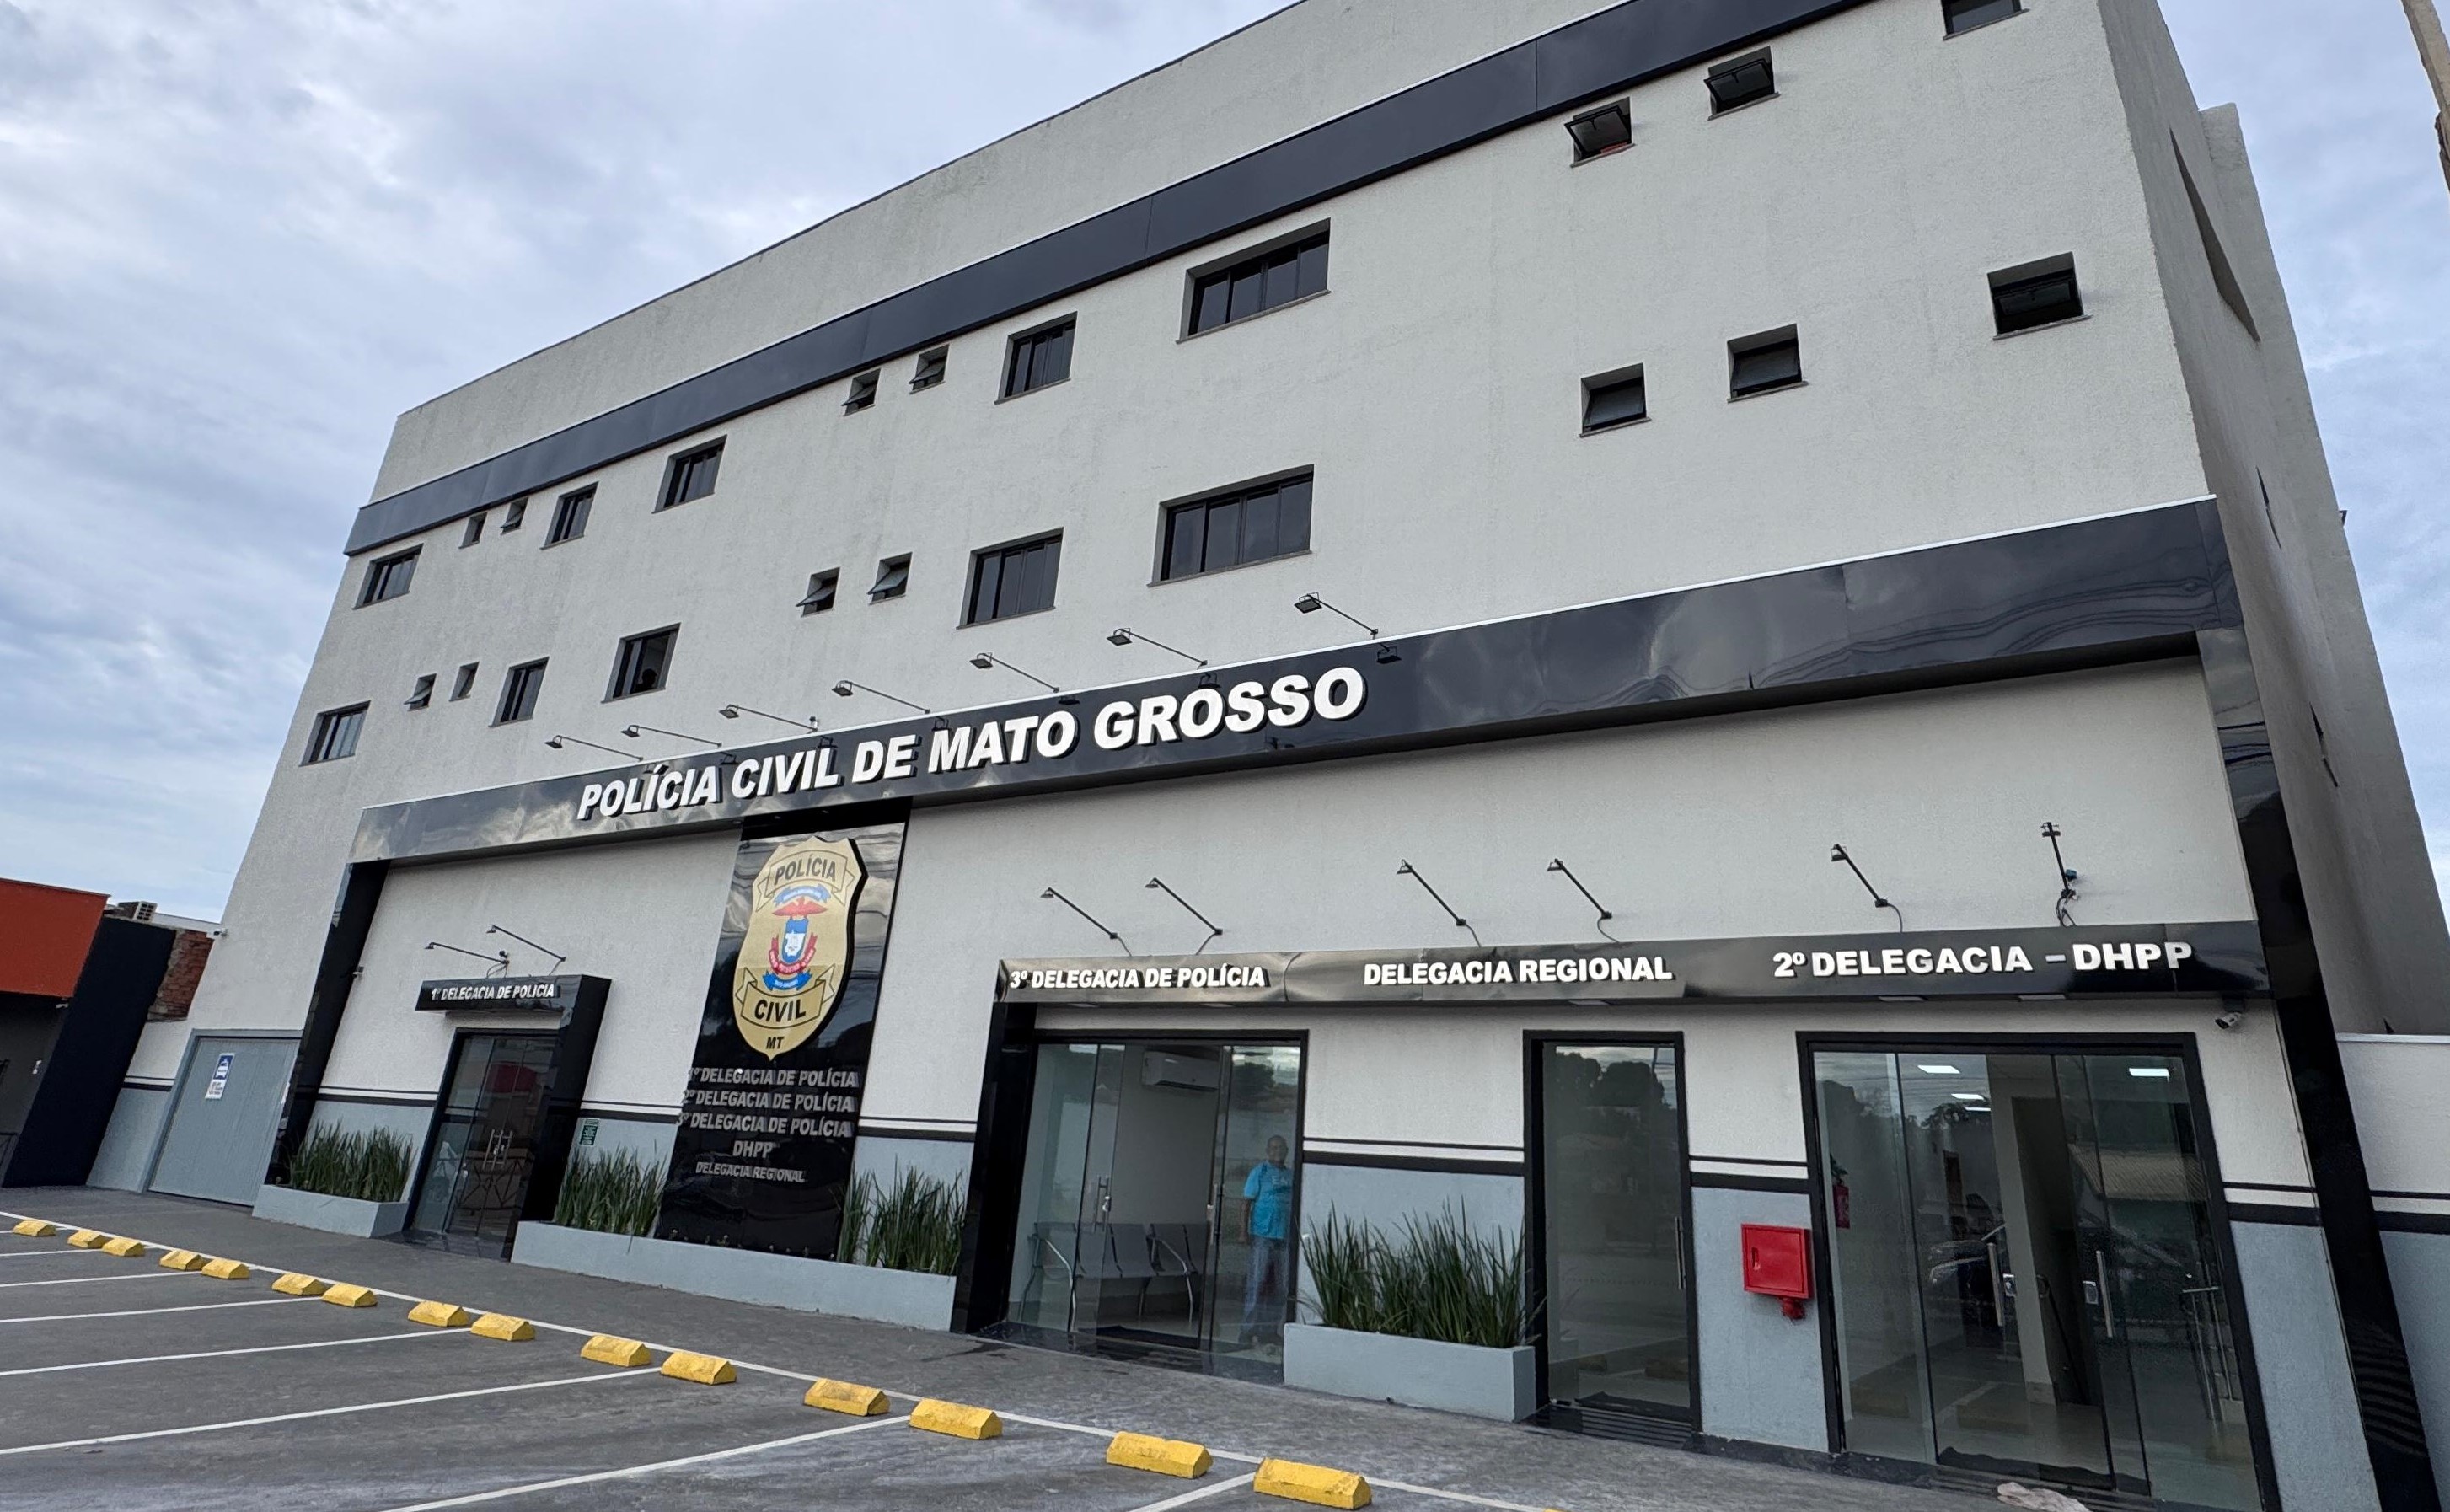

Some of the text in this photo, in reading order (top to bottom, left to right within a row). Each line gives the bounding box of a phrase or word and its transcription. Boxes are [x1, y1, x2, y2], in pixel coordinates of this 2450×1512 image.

[576, 666, 1365, 820] POLÍCIA CIVIL DE MATO GROSSO
[774, 853, 836, 886] POLÍCIA
[1363, 956, 1673, 985] DELEGACIA REGIONAL
[1812, 945, 2033, 979] DELEGACIA
[2072, 941, 2192, 971] DHPP
[1031, 968, 1139, 989] DELEGACIA
[1145, 968, 1175, 988] DE
[1177, 962, 1266, 988] POLÍCIA
[441, 985, 495, 1001] DELEGACIA
[496, 984, 512, 1000] DE
[754, 998, 807, 1023] CIVIL
[765, 1036, 785, 1050] MT
[700, 1067, 775, 1086] DELEGACIA
[776, 1070, 796, 1086] DE
[798, 1067, 859, 1088] POLÍCIA
[695, 1090, 770, 1109] DELEGACIA
[772, 1093, 792, 1110] DE
[794, 1091, 855, 1113] POLÍCIA
[689, 1112, 767, 1134] DELEGACIA
[768, 1116, 789, 1134] DE
[790, 1115, 854, 1138] POLÍCIA
[732, 1140, 775, 1159] DHPP
[695, 1161, 806, 1183] DELEGACIA REGIONAL
